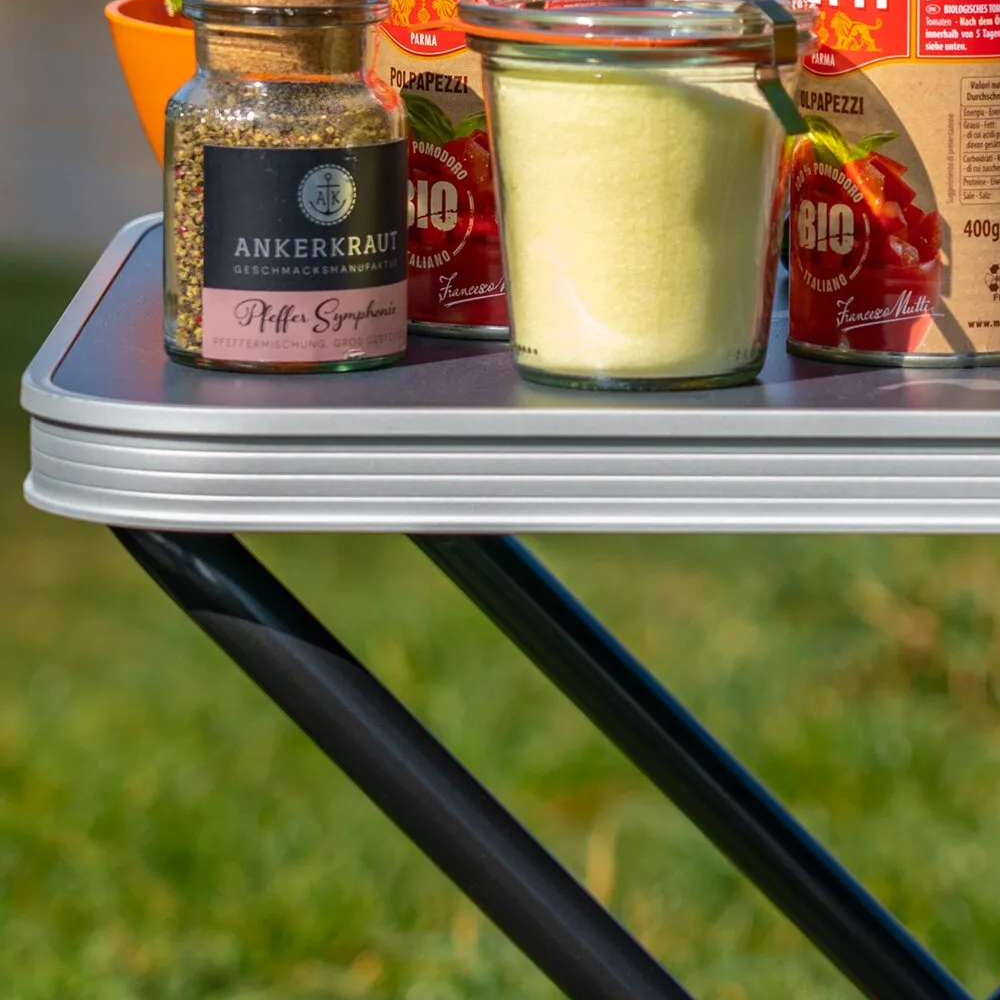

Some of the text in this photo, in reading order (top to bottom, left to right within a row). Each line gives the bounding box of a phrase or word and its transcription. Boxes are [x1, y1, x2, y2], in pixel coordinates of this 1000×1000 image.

[944, 4, 988, 14] BIOLOGISCHES
[926, 18, 952, 26] Tomaten
[960, 17, 976, 26] Nach
[978, 17, 992, 25] dem
[410, 32, 437, 46] PARMA
[925, 29, 959, 39] innerhalb
[976, 29, 980, 37] 5
[982, 28, 1000, 40] Tagen
[925, 42, 967, 51] siehe unten.
[811, 53, 836, 67] PARMA
[390, 67, 468, 94] POLPAPEZZI
[970, 81, 990, 90] Valori
[800, 90, 864, 115] OLPAPEZZI
[412, 140, 468, 181] POMODORO
[813, 162, 865, 204] POMODORO
[963, 191, 975, 199] Sale
[797, 199, 855, 256] BIO
[964, 219, 1000, 242] 400g
[234, 230, 399, 259] ANKERKRAUT
[408, 249, 451, 268] ALIANO
[803, 272, 849, 294] ITALIANO
[234, 297, 397, 334] Pfeffer Symphonie
